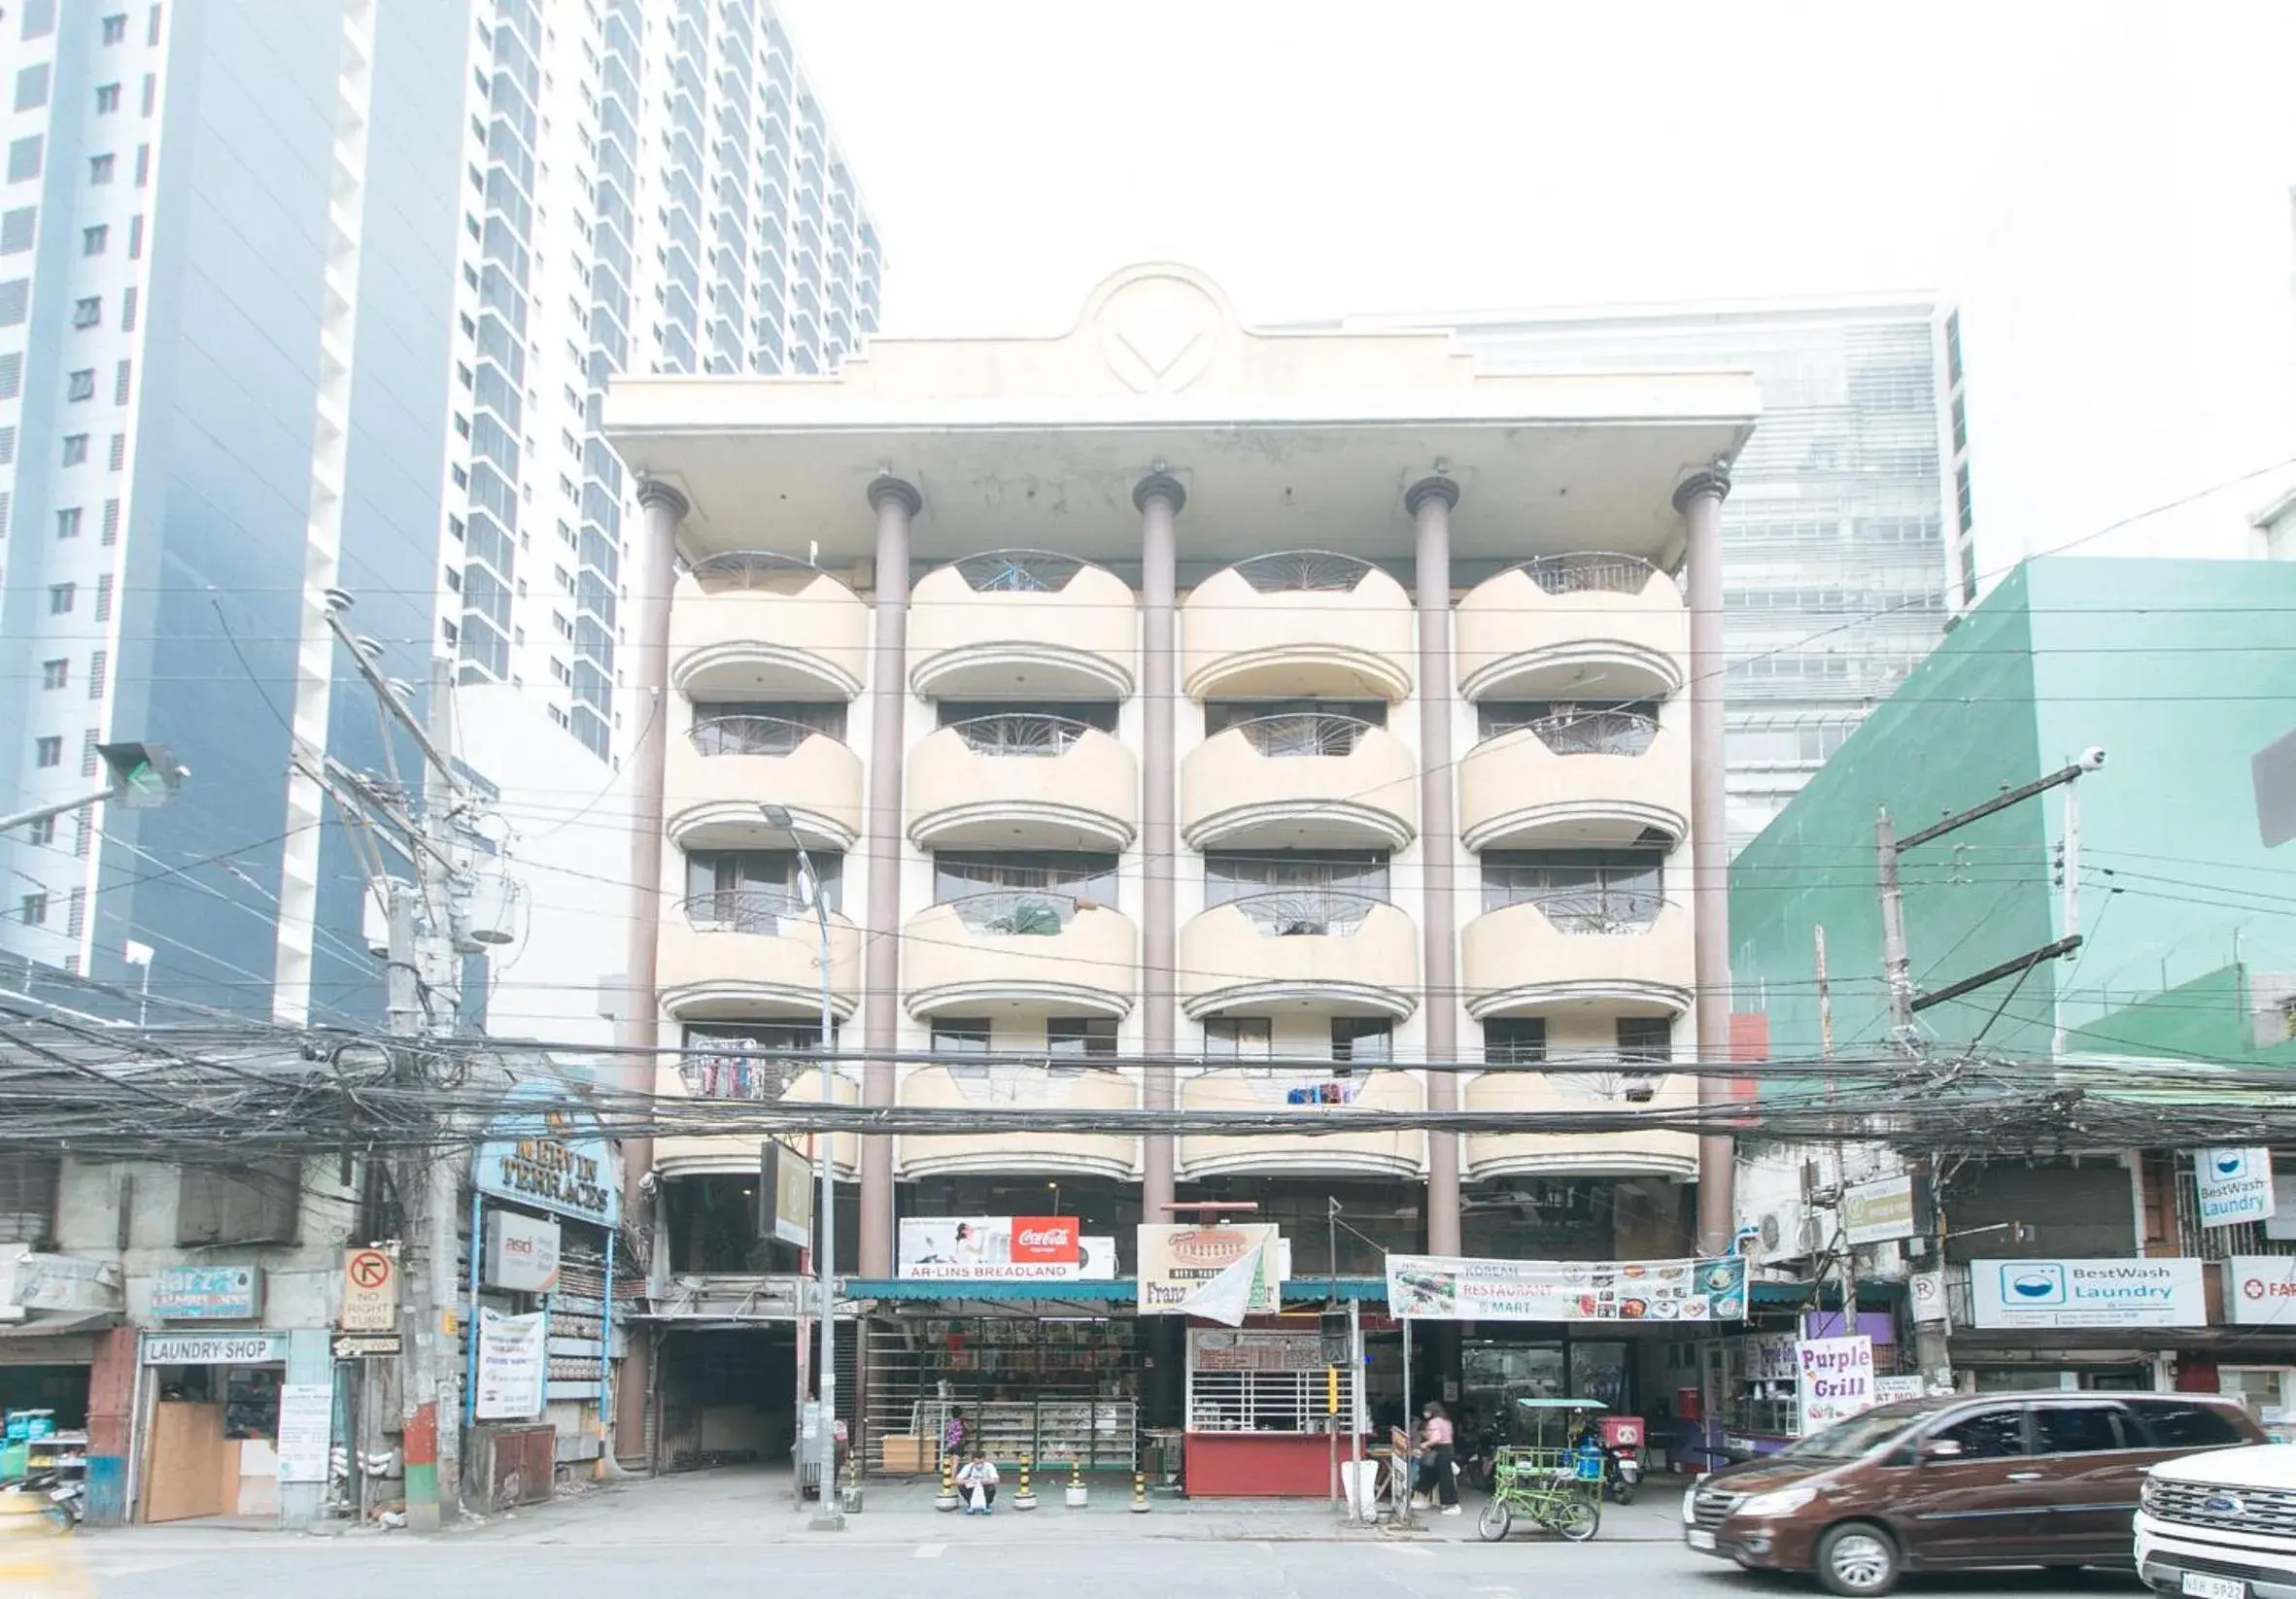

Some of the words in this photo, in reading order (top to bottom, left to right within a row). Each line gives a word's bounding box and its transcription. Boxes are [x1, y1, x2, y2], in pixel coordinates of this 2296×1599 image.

[499, 1153, 609, 1212] TERRACES
[2201, 1178, 2265, 1200] BestWash
[2203, 1195, 2265, 1216] Laundry
[910, 1267, 970, 1277] AR-LINS
[975, 1267, 1067, 1277] BREADLAND
[1465, 1265, 1518, 1277] KOREAN
[2073, 1266, 2171, 1278] BestWash
[357, 1292, 380, 1302] NO
[1147, 1281, 1187, 1304] Franz
[1463, 1284, 1554, 1297] RESTAURANT
[2075, 1285, 2173, 1300] Laundry
[347, 1304, 389, 1314] RIGHT
[1491, 1301, 1530, 1313] MART
[351, 1315, 388, 1325] TURN
[150, 1343, 220, 1360] LAUNDRY
[225, 1341, 267, 1358] SHOP
[1801, 1346, 1870, 1373] Purple
[1814, 1378, 1866, 1397] Grill
